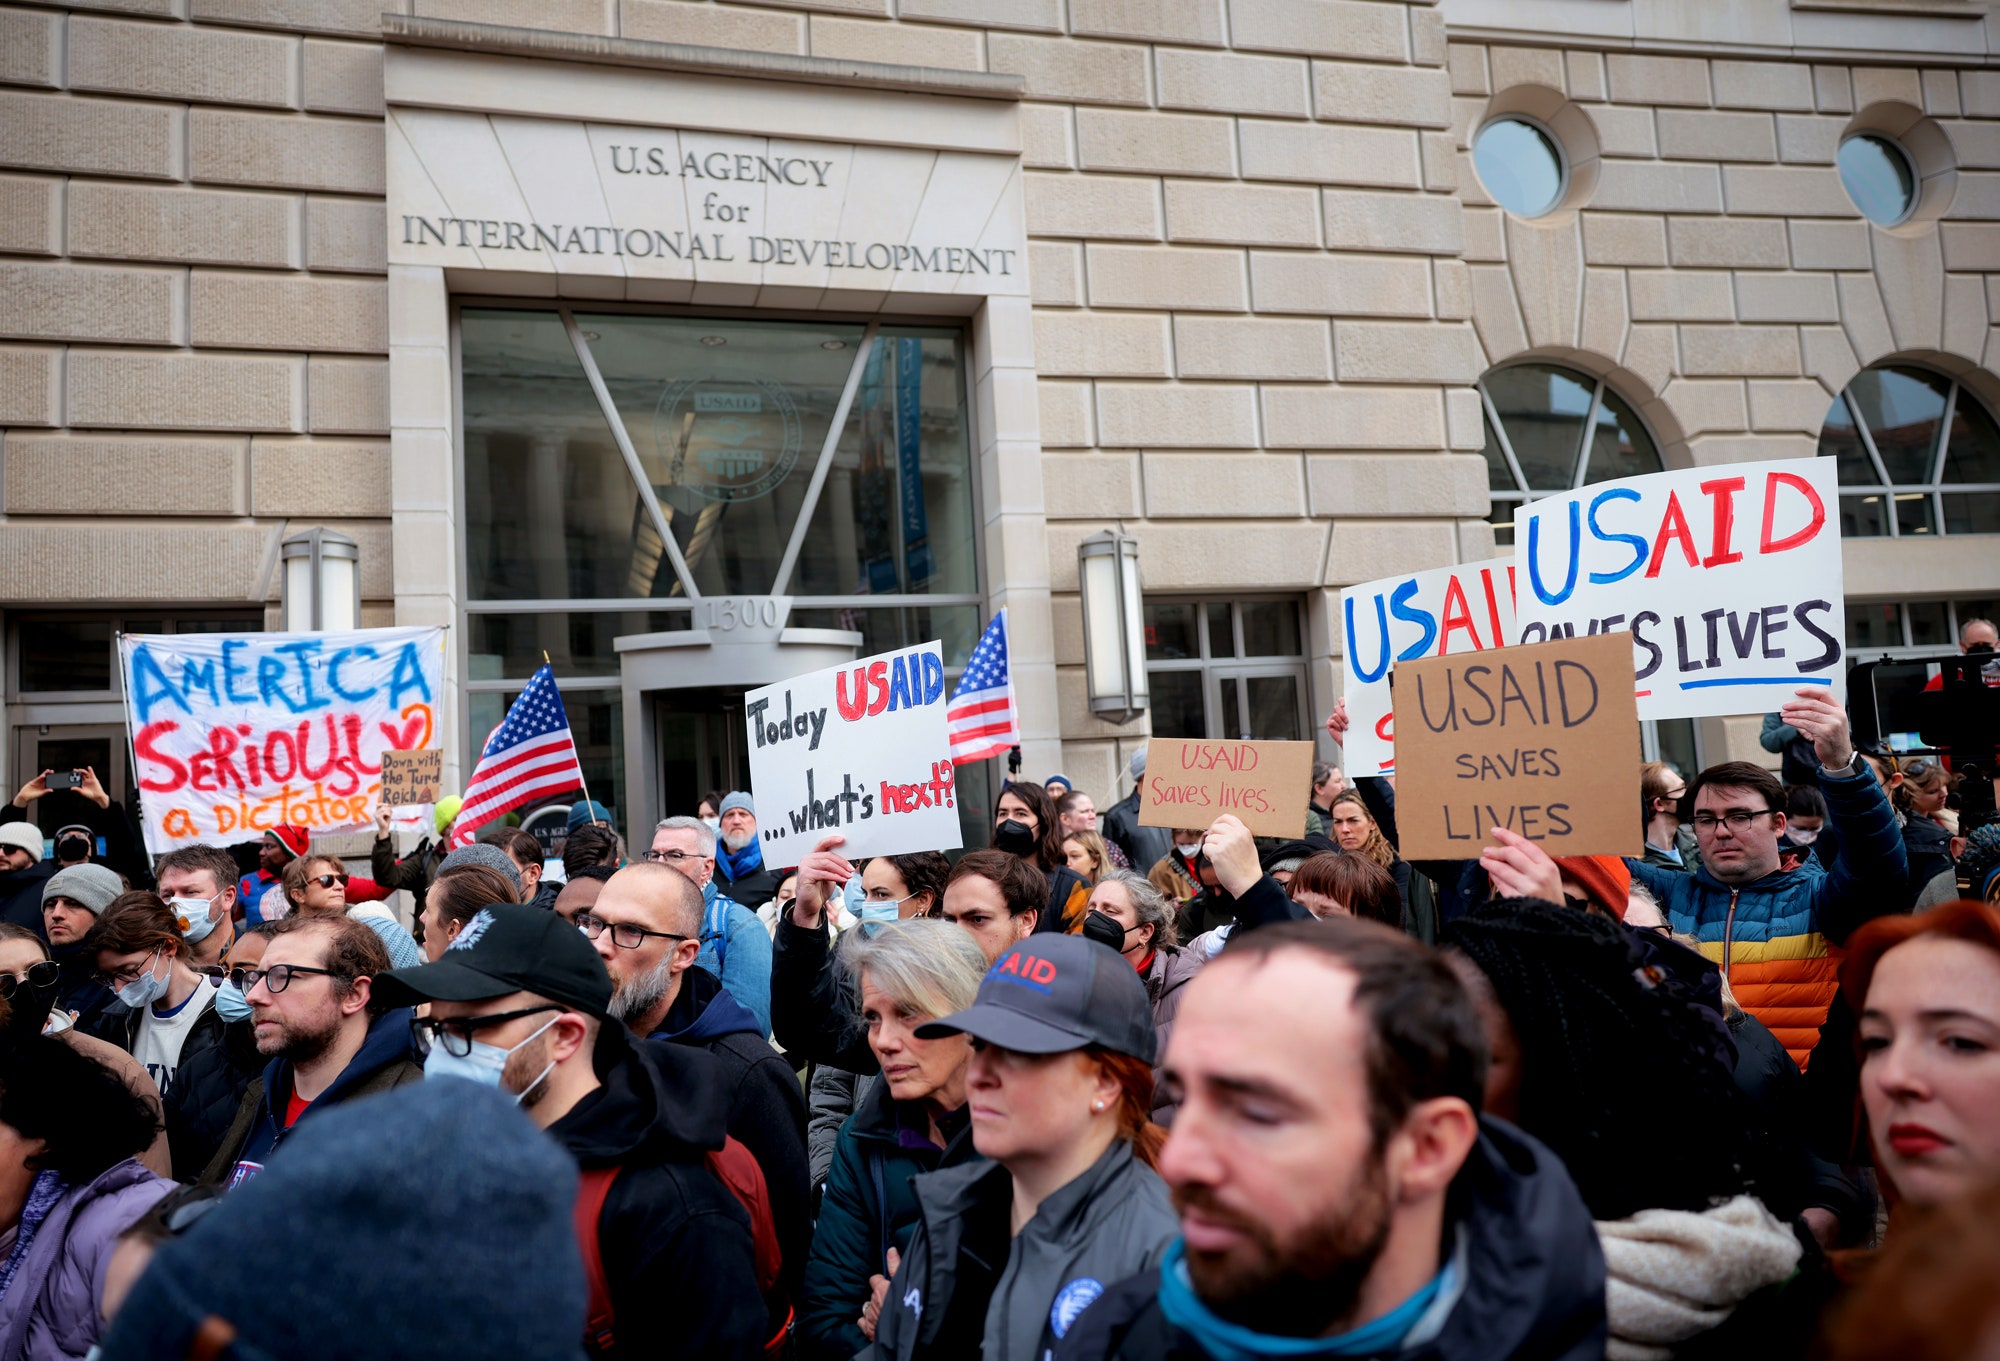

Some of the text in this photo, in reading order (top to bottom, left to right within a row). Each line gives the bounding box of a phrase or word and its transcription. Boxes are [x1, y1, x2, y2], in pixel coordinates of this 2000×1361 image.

[610, 145, 832, 187] U.S. AGENCY
[703, 192, 749, 222] for
[401, 215, 1016, 275] INTERNATIONAL DEVELOPMENT
[700, 396, 757, 408] USAID
[1528, 470, 1827, 606] USAID
[706, 600, 778, 632] 1300
[1344, 565, 1518, 684] USAI
[1673, 599, 1842, 674] LIVES
[131, 640, 432, 721] AMERICA
[1417, 660, 1599, 733] USAID
[747, 652, 944, 751] Today USAID
[381, 767, 440, 785] the Turd
[383, 751, 440, 769] Down with
[1181, 744, 1259, 772] USAID
[1456, 748, 1561, 781] SAVES
[383, 785, 417, 804] Reich
[1151, 776, 1276, 813] Saves lives.
[162, 808, 200, 839] a
[1443, 803, 1573, 840] LIVES
